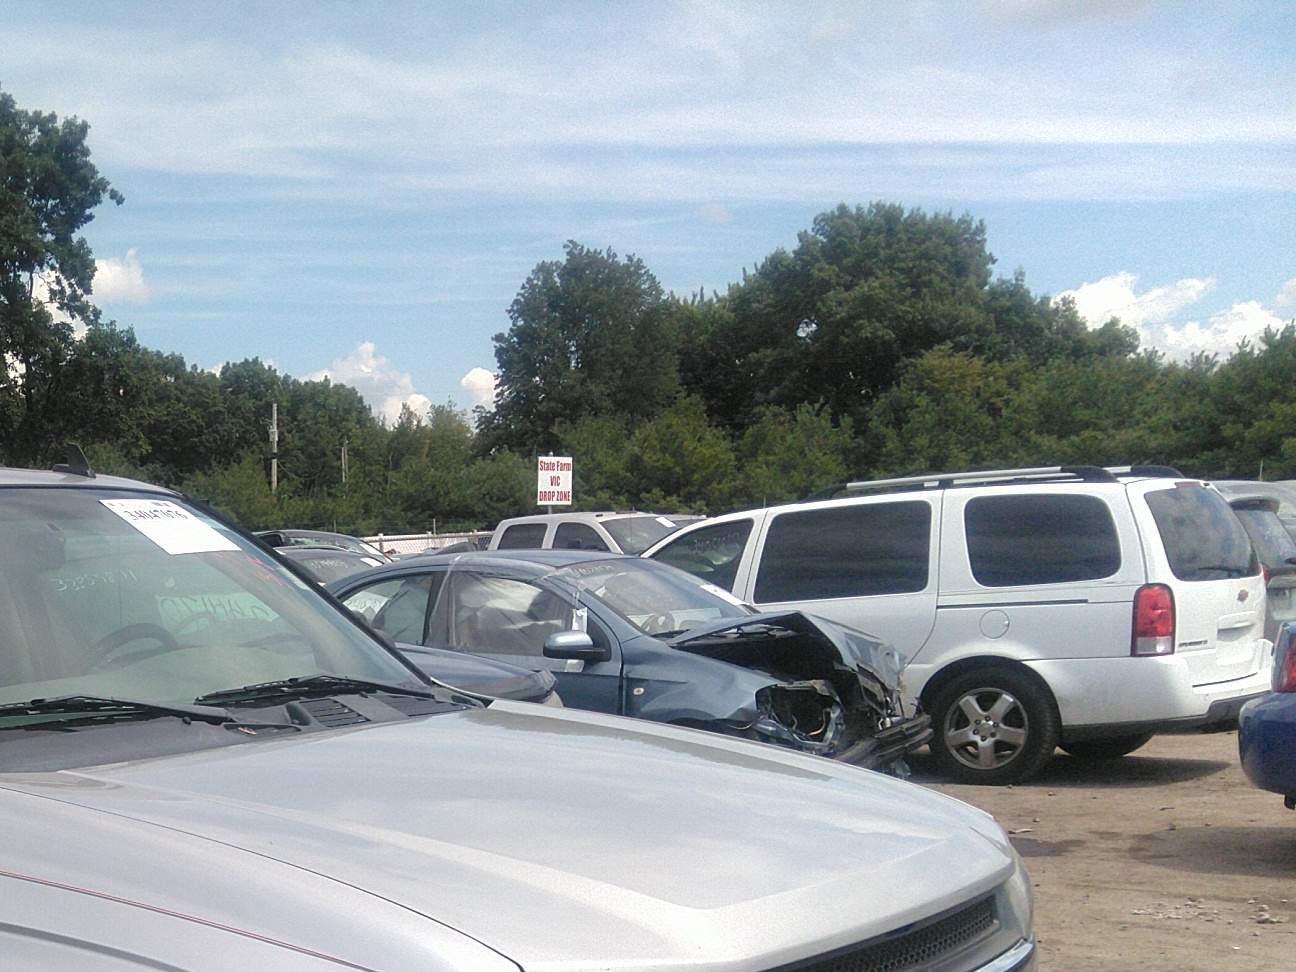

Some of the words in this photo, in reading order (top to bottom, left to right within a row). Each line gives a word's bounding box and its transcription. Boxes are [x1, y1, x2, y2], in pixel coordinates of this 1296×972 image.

[539, 460, 555, 471] State
[556, 460, 571, 471] Farm
[550, 475, 561, 487] VIC
[539, 490, 555, 502] DROP
[556, 490, 570, 502] ZONE
